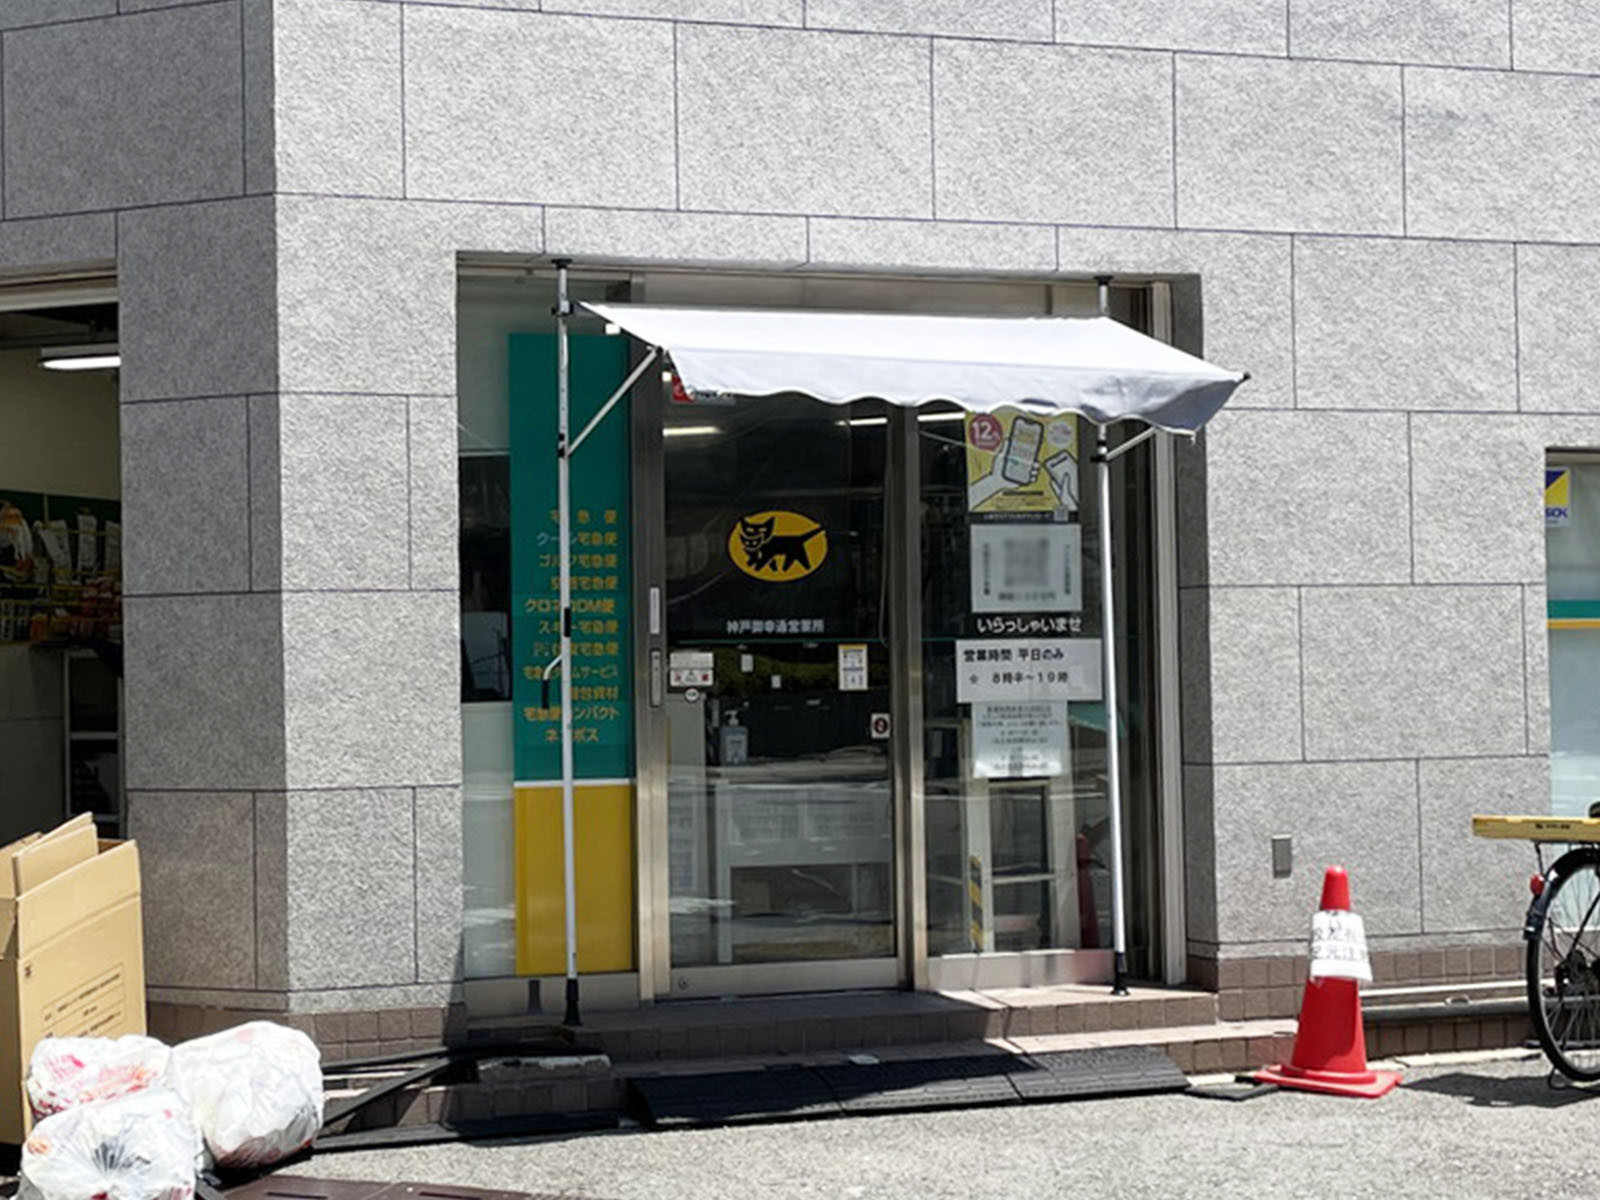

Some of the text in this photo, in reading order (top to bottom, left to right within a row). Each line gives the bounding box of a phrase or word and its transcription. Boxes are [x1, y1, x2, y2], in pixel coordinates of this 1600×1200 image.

[976, 616, 1082, 633] いらっしゃいませ
[963, 648, 1065, 662] 営業時間 平日のみ
[523, 706, 619, 721] 宅急便ンパクト
[545, 727, 600, 742] ネポス
